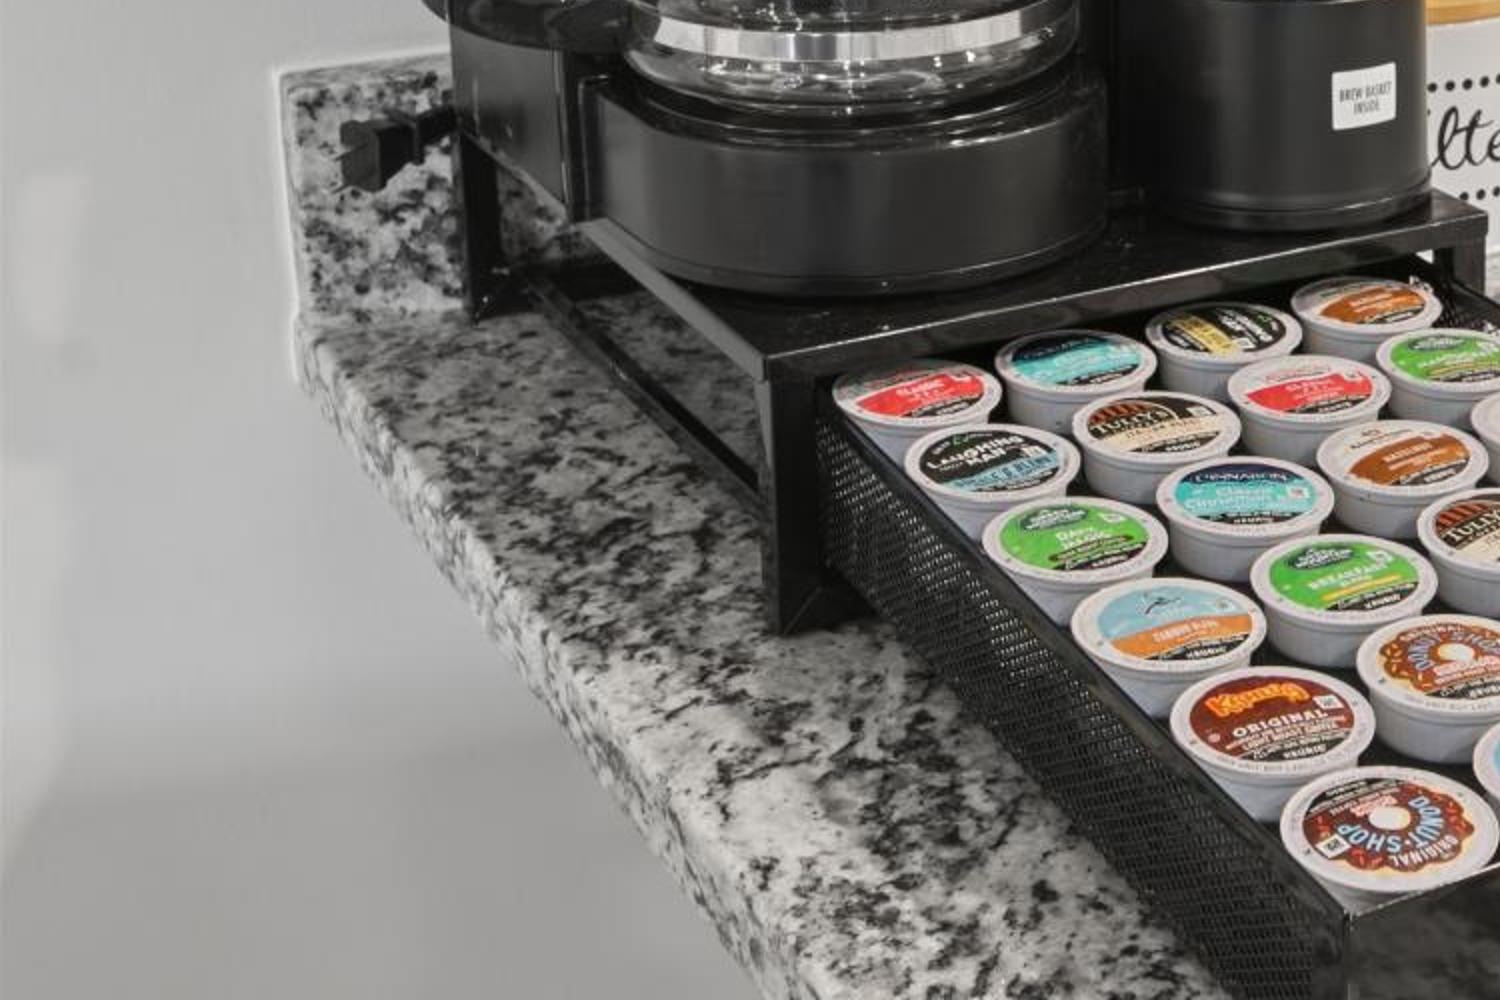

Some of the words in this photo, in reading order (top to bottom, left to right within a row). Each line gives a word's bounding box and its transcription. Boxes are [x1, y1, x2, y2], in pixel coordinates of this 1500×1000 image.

[1339, 87, 1363, 105] BREW
[1364, 80, 1393, 99] BASKET
[1353, 98, 1381, 116] INSIDE
[1232, 708, 1330, 738] ORIGINAL
[1407, 795, 1445, 849] DONUT
[1336, 822, 1402, 855] SHOP
[1389, 834, 1459, 867] ORIGINAL
